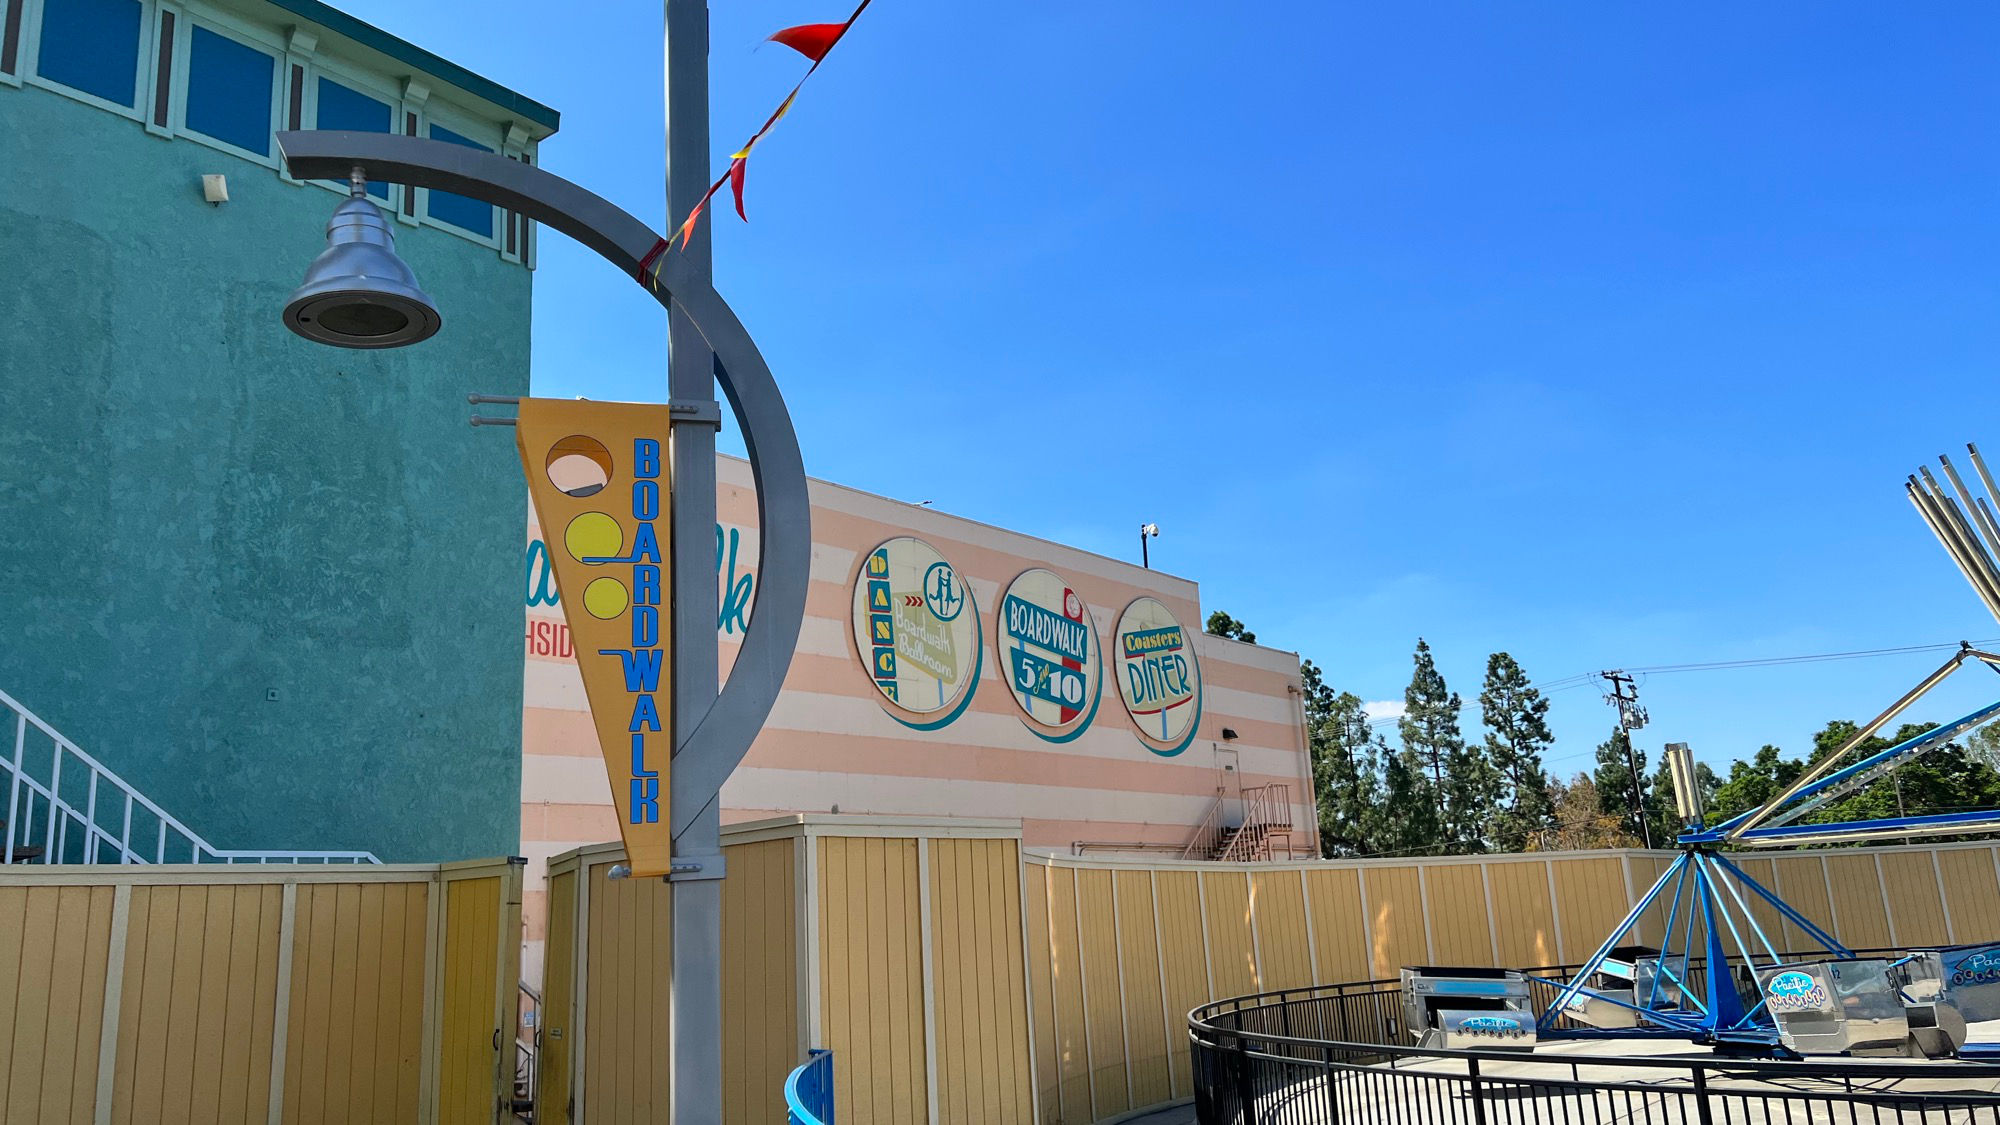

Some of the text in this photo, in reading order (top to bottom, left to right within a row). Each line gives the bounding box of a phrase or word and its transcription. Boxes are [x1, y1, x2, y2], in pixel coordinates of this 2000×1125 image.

[600, 438, 664, 824] BOARDWALK
[894, 598, 950, 655] Boardwalk
[1010, 600, 1084, 658] BOARDWALK
[1126, 632, 1181, 651] Coasters
[899, 633, 952, 679] Ballroom
[1127, 654, 1191, 704] DINER
[1019, 658, 1036, 688] 5
[1049, 670, 1083, 704] 10
[1772, 976, 1809, 993] Pacific
[1468, 1018, 1512, 1030] Pacific
